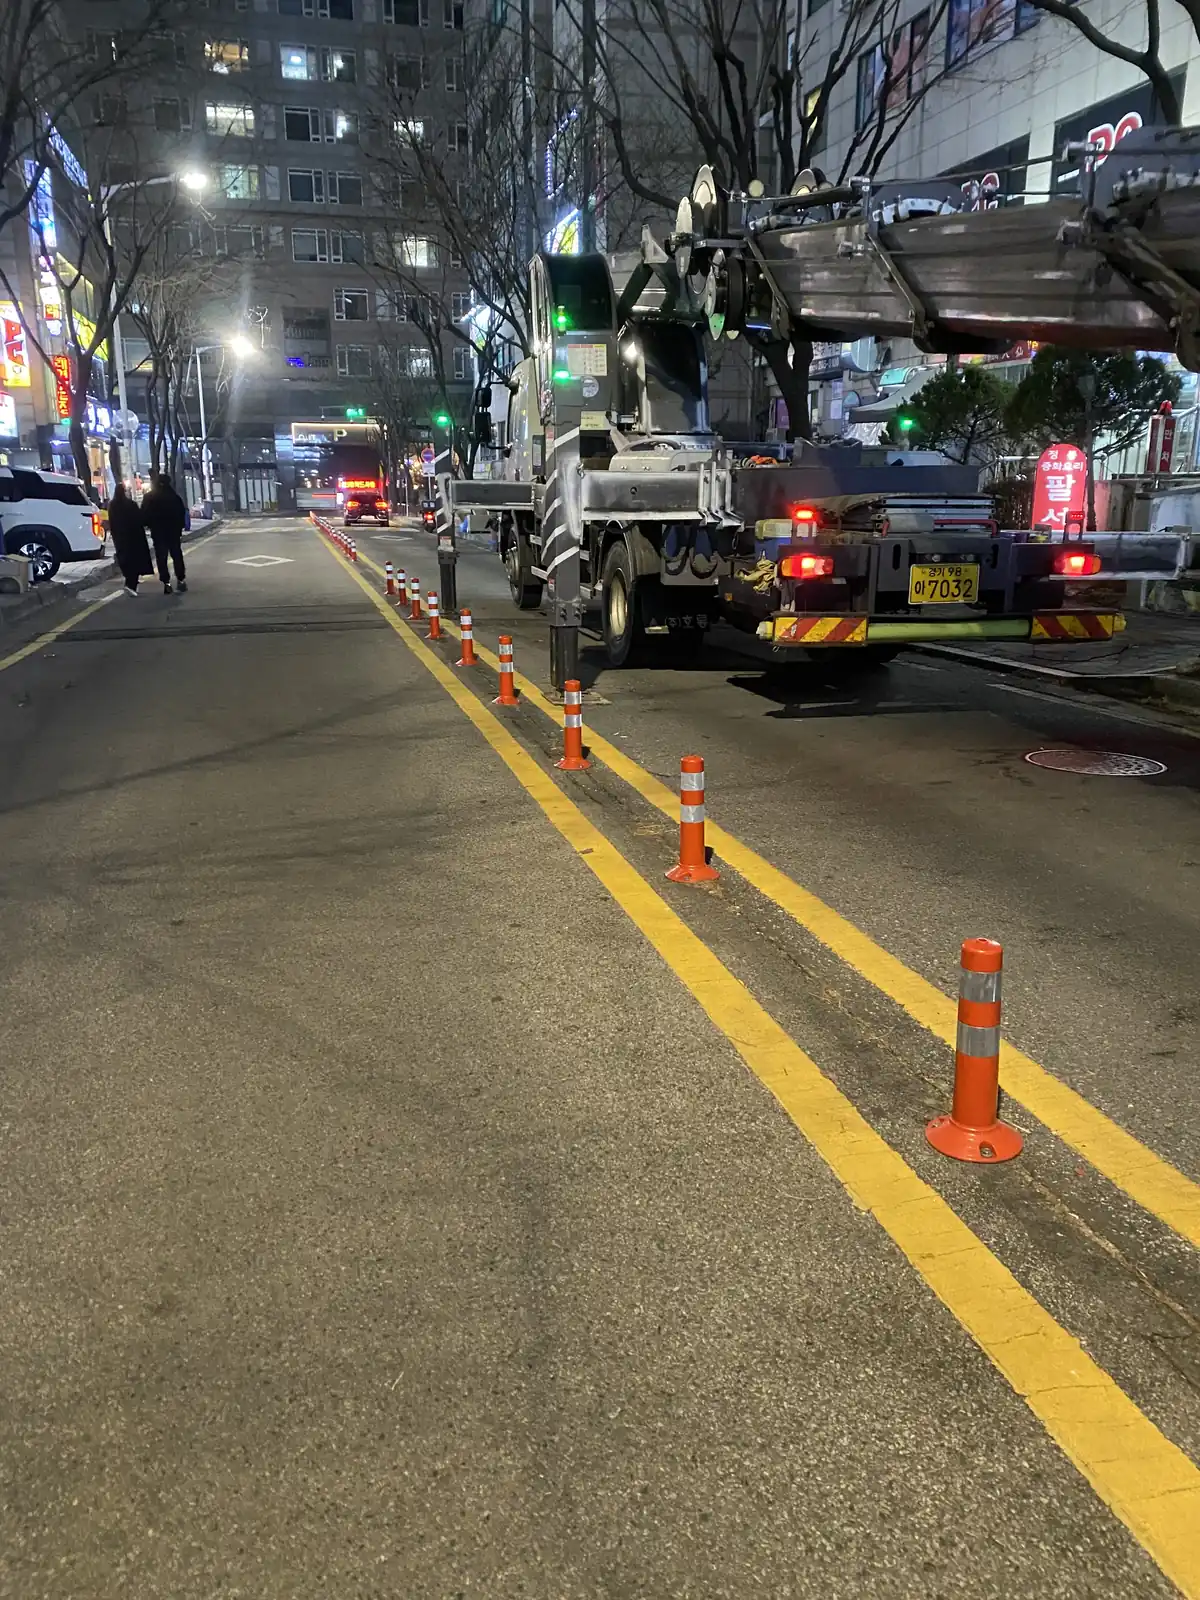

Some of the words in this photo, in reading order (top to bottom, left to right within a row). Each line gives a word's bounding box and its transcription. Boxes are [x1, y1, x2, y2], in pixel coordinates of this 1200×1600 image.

[334, 428, 348, 442] P
[1041, 461, 1084, 472] 중화요리
[929, 567, 946, 578] 경기
[948, 566, 962, 577] 98
